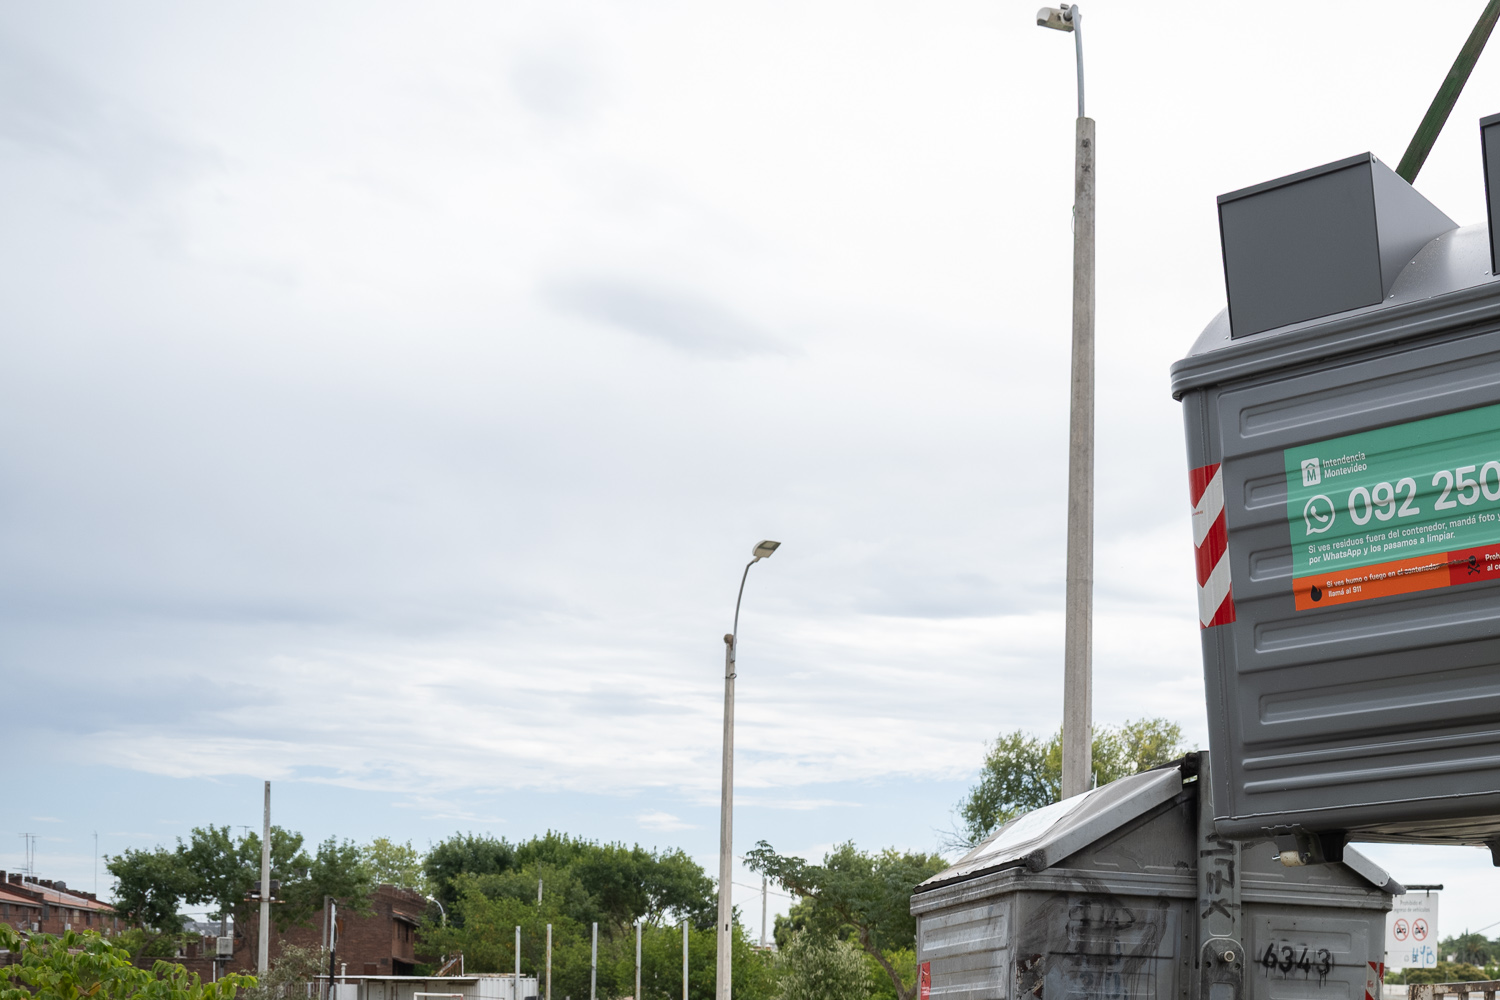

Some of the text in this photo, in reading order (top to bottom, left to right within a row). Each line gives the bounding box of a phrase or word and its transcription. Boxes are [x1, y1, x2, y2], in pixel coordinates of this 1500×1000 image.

[1322, 451, 1366, 468] Intendencia
[1324, 463, 1367, 478] Montevideo
[1348, 477, 1420, 525] 092
[1308, 545, 1316, 554] Si
[1317, 544, 1331, 552] ves
[1332, 538, 1364, 549] residuos
[1366, 534, 1386, 543] fuera
[1388, 529, 1400, 539] del
[1402, 522, 1447, 537] contenedor,
[1449, 515, 1476, 528] mandá
[1478, 514, 1495, 523] foto
[1309, 556, 1321, 566] por
[1323, 548, 1362, 561] WhatsApp
[1363, 547, 1368, 556] y
[1370, 545, 1381, 553] los
[1383, 538, 1418, 552] pasamos
[1427, 531, 1455, 542] limpiar.
[1328, 588, 1345, 597] llamá
[1352, 585, 1362, 593] 911
[1262, 943, 1331, 977] 6343
